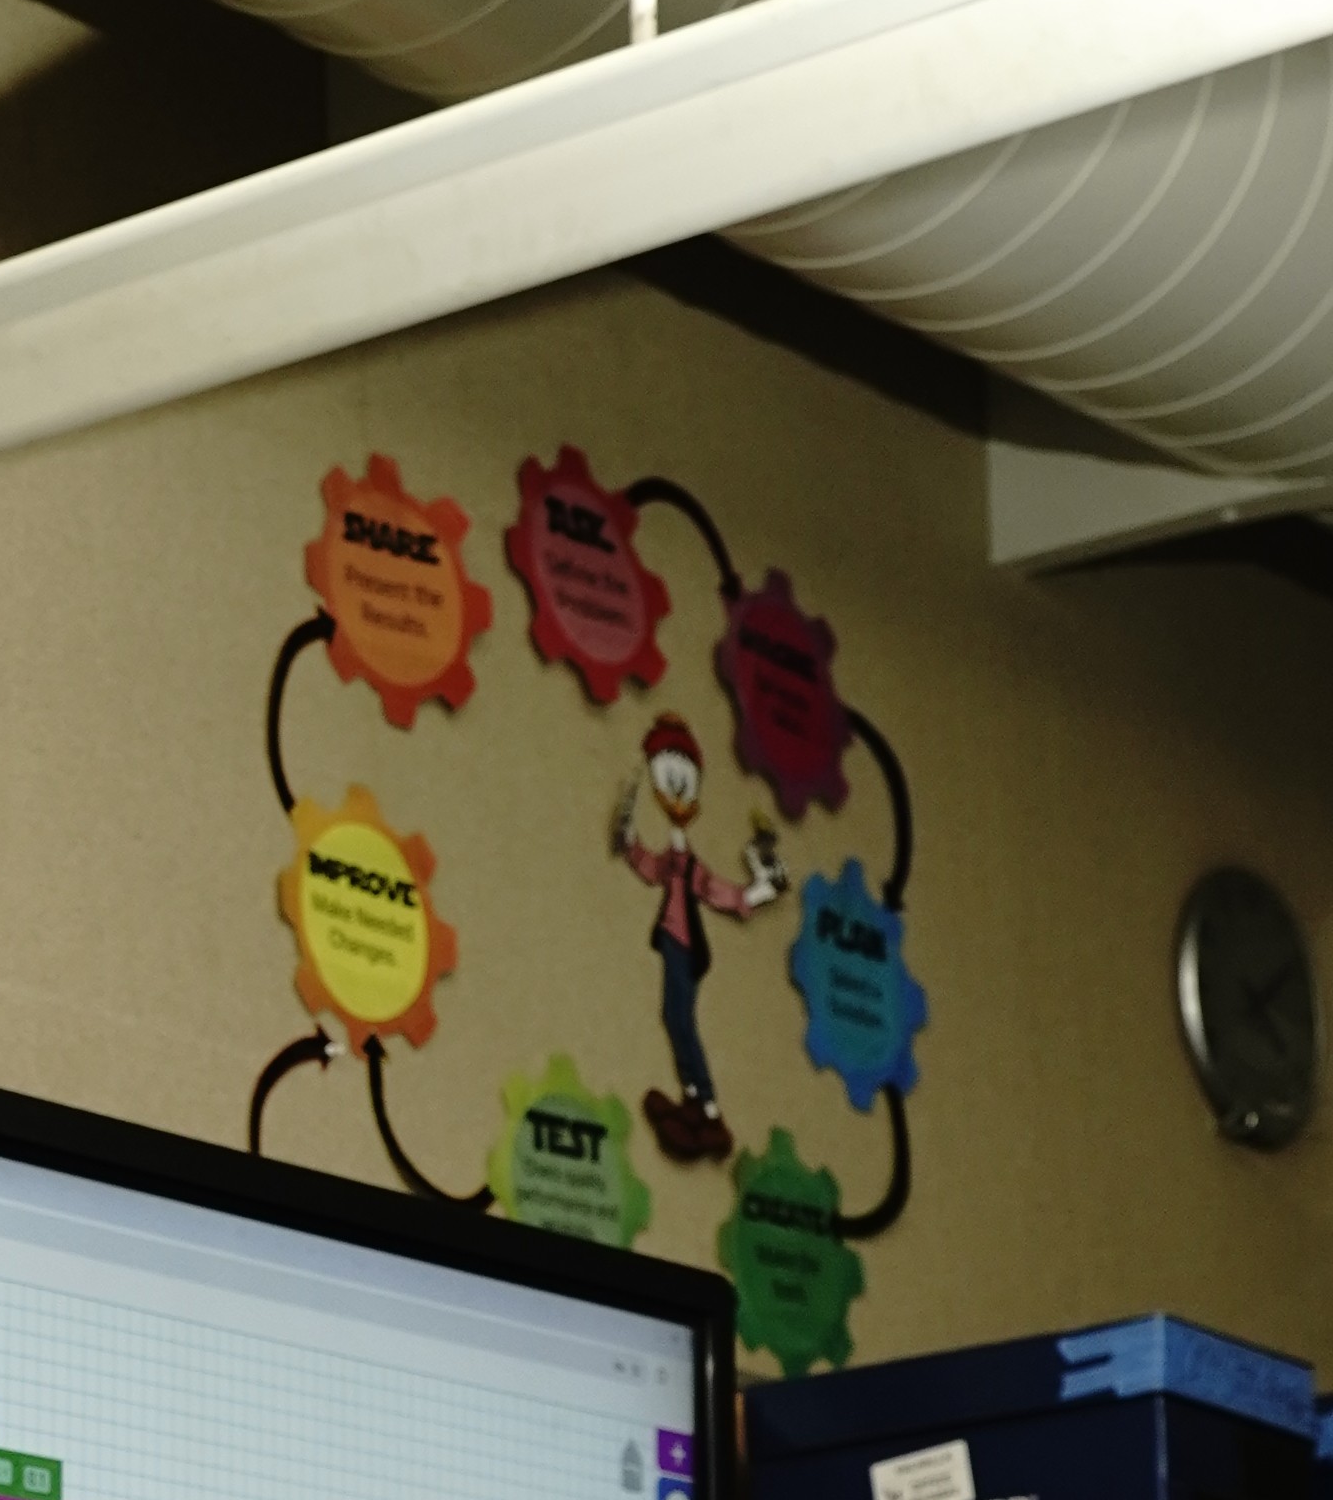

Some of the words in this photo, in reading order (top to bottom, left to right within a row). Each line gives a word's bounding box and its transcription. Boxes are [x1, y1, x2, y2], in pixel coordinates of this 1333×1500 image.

[343, 512, 440, 564] SHARE
[308, 850, 417, 907] IMPROVE
[525, 1109, 608, 1164] TEST
